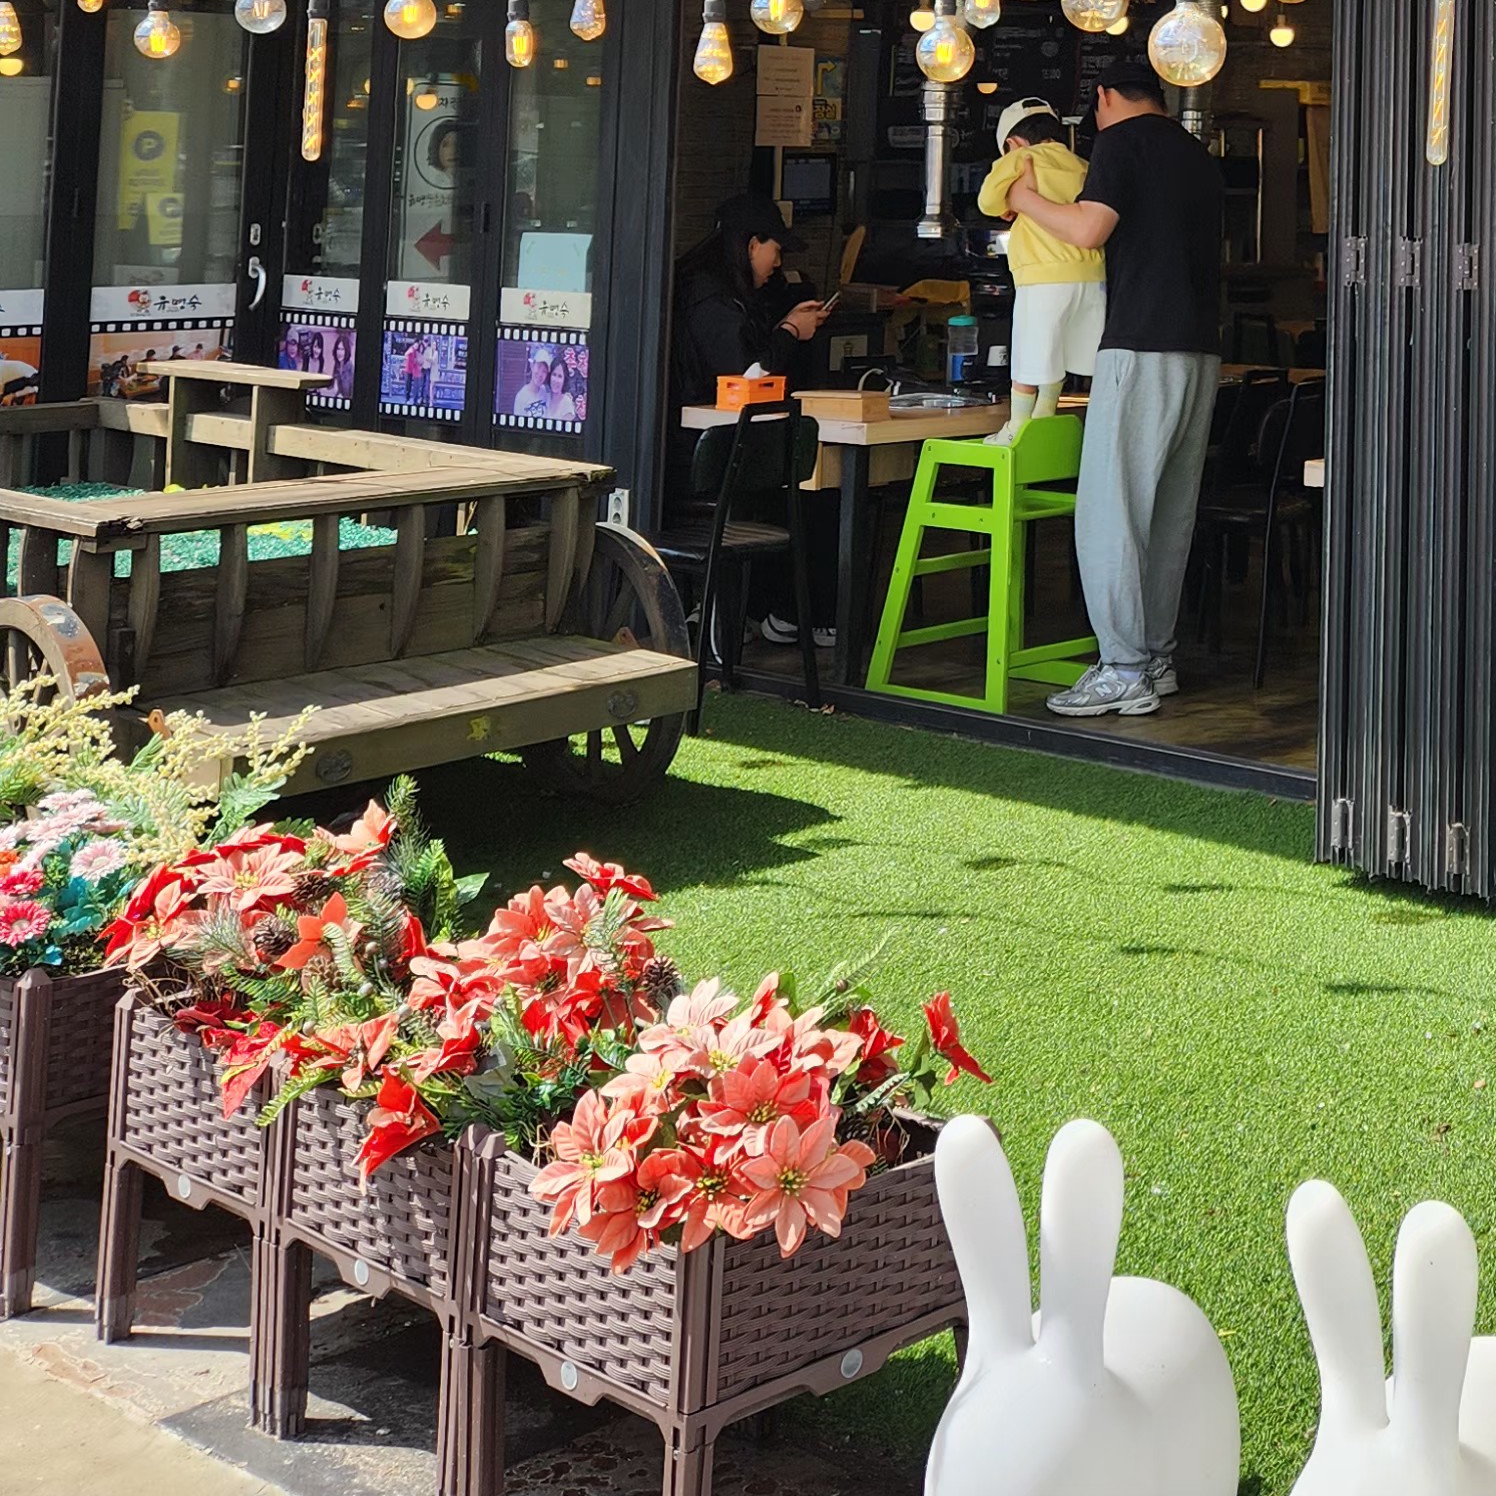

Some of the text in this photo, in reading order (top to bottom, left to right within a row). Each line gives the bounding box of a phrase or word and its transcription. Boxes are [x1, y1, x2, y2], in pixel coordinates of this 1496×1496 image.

[153, 294, 203, 312] 유명숙
[314, 287, 341, 304] 유명숙
[422, 292, 450, 311] 유명숙
[539, 300, 570, 319] 유명숙
